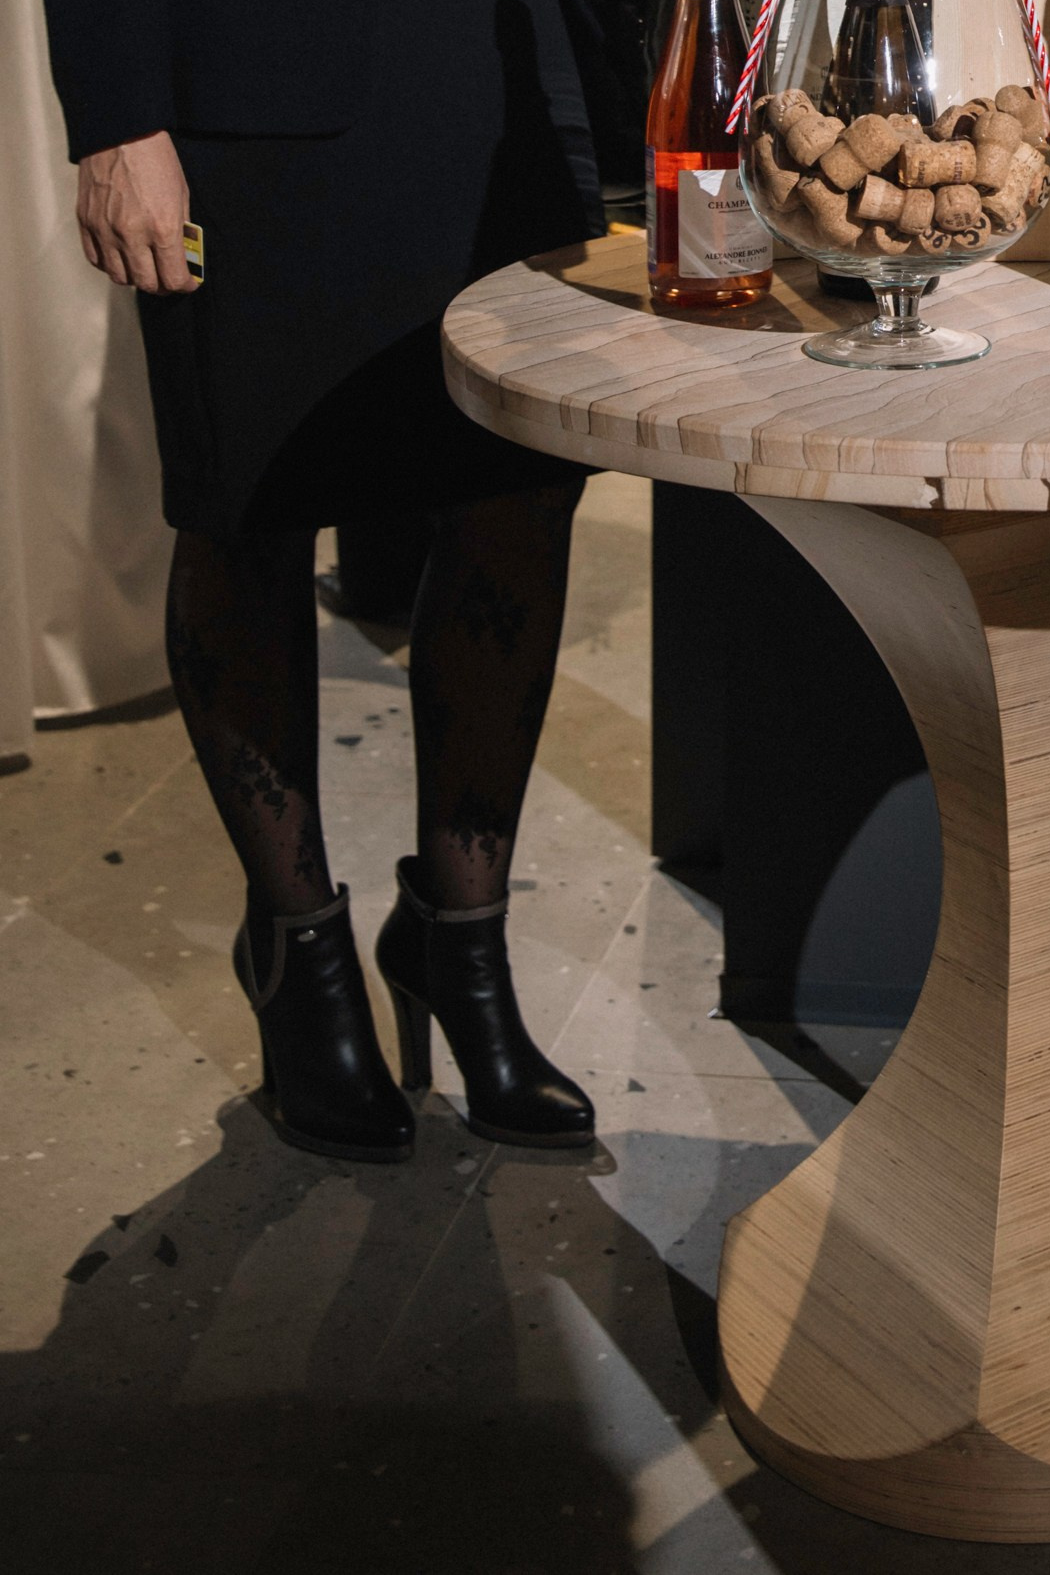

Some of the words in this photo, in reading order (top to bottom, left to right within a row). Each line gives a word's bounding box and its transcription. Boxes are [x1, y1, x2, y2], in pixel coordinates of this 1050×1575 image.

[708, 200, 751, 209] CHAMPA
[704, 250, 746, 260] ALEXANDRE
[746, 246, 768, 257] BONNET
